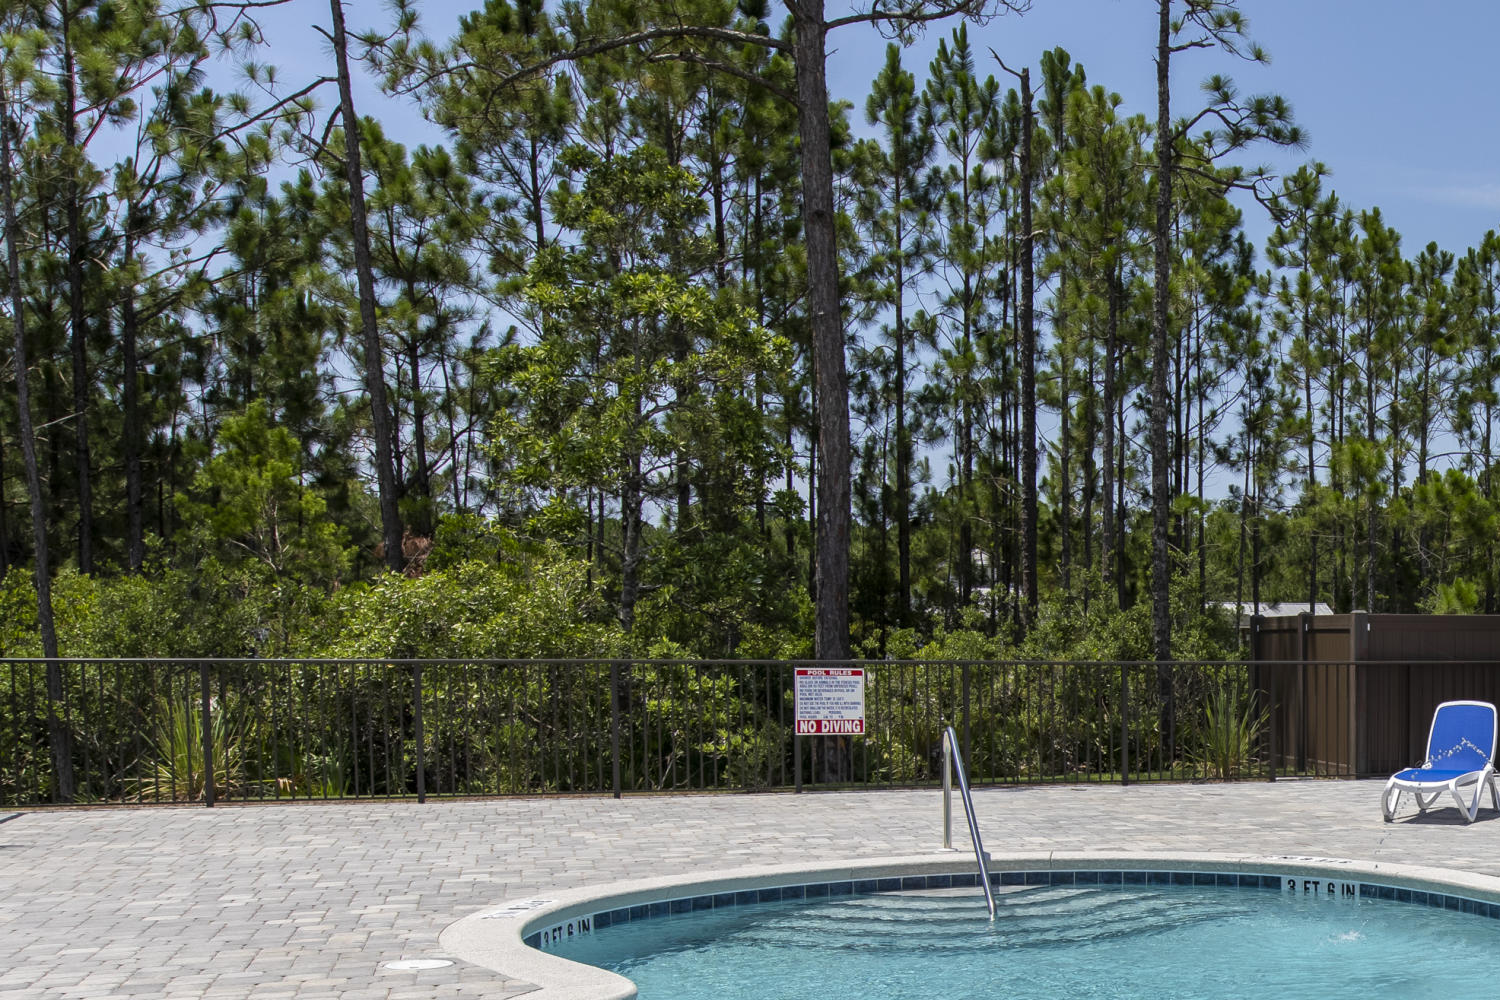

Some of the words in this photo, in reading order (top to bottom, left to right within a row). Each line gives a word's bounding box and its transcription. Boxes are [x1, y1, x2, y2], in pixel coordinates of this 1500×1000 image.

[800, 720, 817, 733] NO
[822, 720, 860, 733] DIVING
[1304, 881, 1320, 892] FT
[1341, 883, 1355, 896] IN
[552, 926, 563, 941] FT
[578, 918, 590, 934] IN
